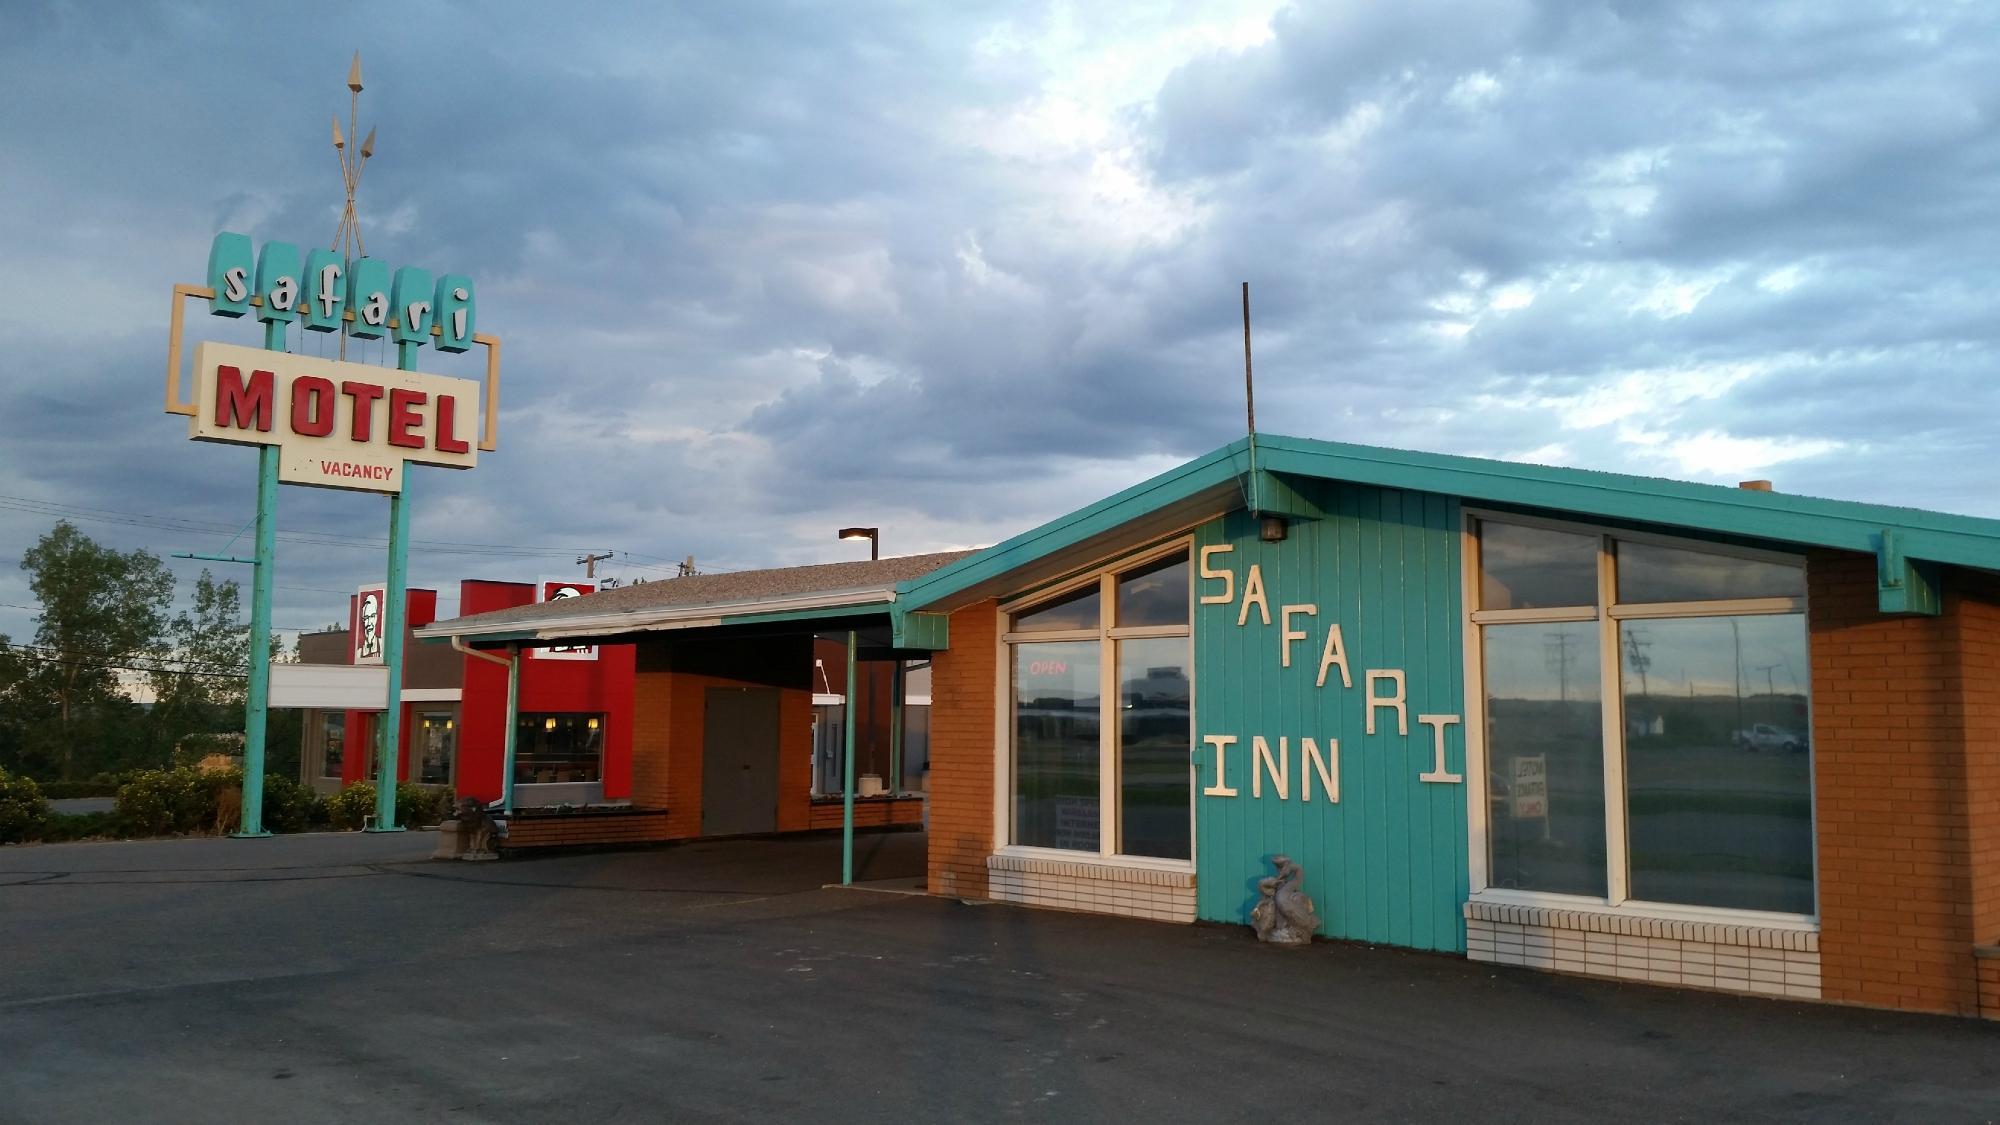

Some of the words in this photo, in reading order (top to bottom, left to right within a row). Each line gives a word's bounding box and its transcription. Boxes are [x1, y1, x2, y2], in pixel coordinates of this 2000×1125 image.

[223, 264, 469, 340] safari
[214, 364, 470, 455] MOTEL
[321, 461, 393, 481] VACANCY
[1030, 661, 1067, 675] OPEN
[1200, 543, 1462, 783] SAFARI
[1203, 735, 1340, 804] INN
